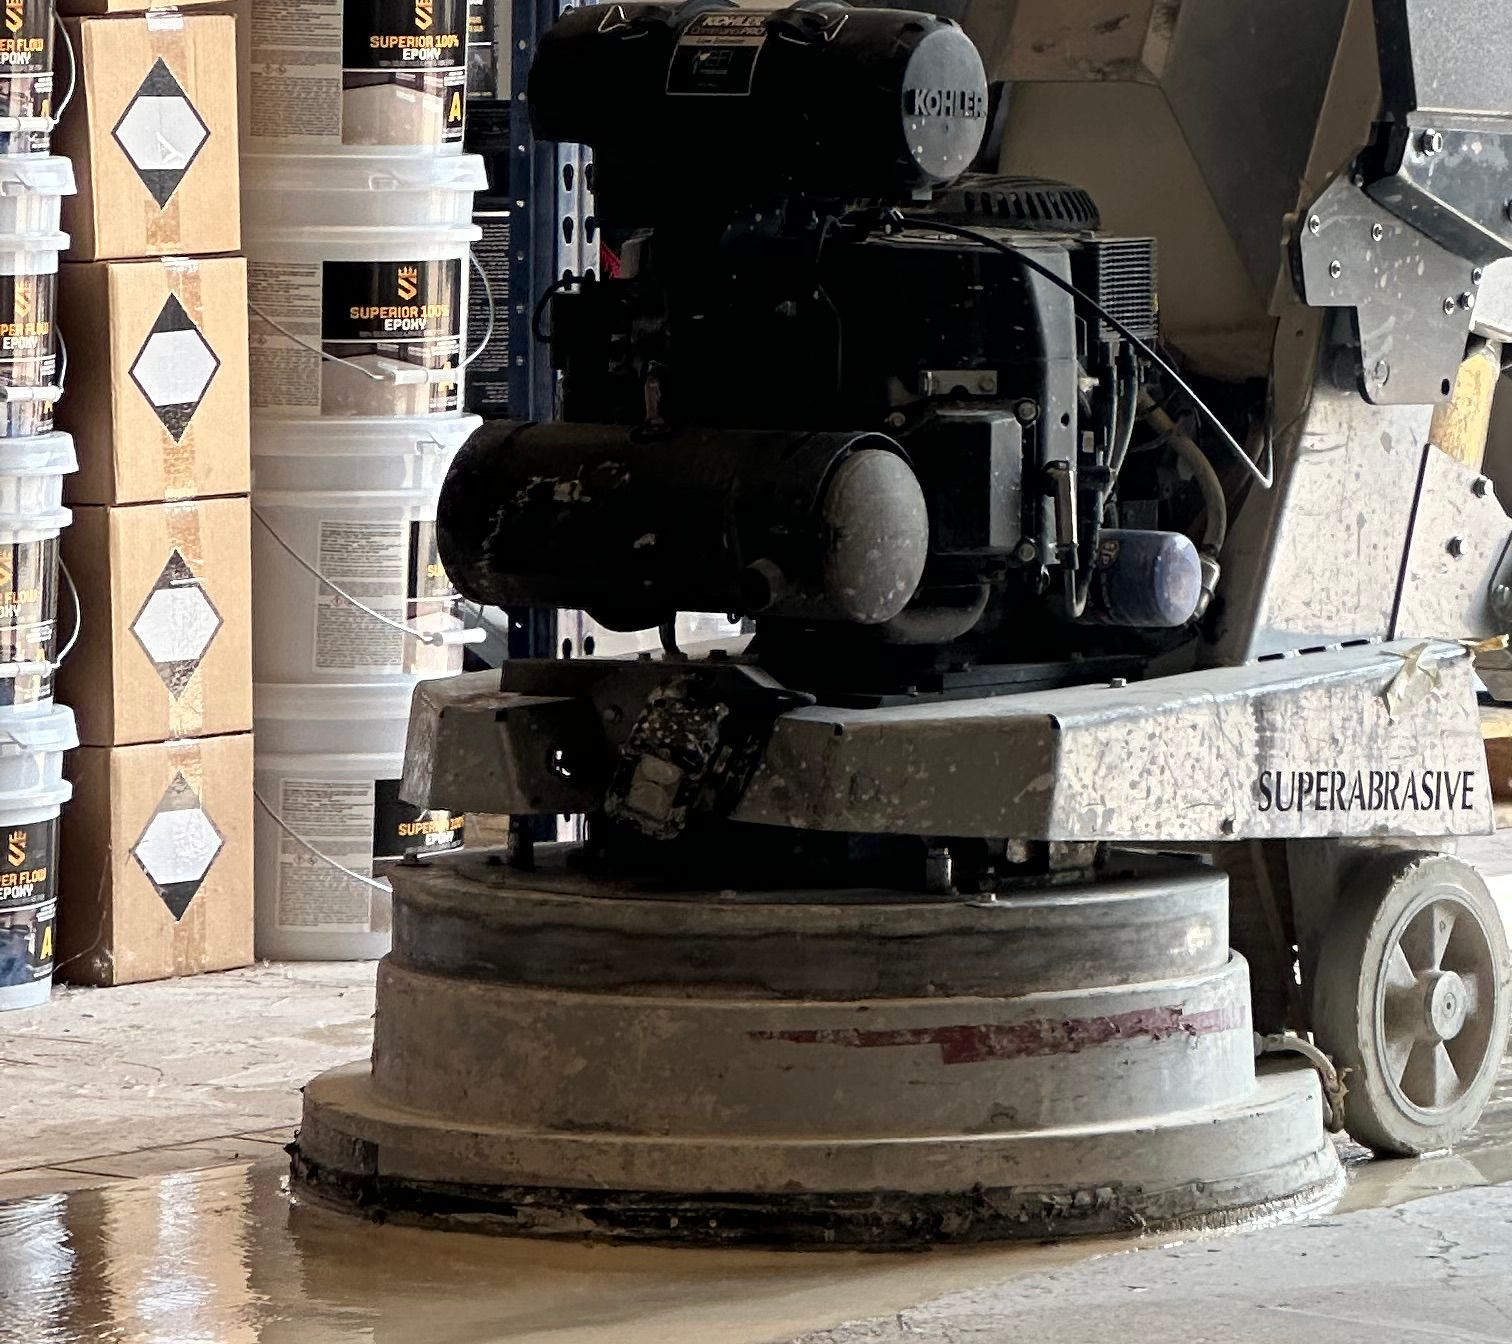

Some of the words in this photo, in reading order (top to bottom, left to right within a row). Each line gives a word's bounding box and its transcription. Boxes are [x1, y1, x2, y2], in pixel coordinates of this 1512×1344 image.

[702, 14, 767, 27] KOHLER
[17, 38, 44, 52] FLOW
[370, 35, 434, 49] SUPERIOR
[435, 34, 459, 48] 100%
[402, 47, 442, 61] EPOXY
[448, 91, 462, 123] A
[914, 88, 987, 120] KOHLER
[350, 306, 419, 319] SUPERIOR
[384, 318, 427, 331] EPOXY
[2, 336, 38, 350] EPOXY
[4, 588, 39, 605] FLOW
[1258, 769, 1475, 812] SUPERABRASIVE
[19, 867, 47, 884] FLOW
[39, 926, 53, 961] A
